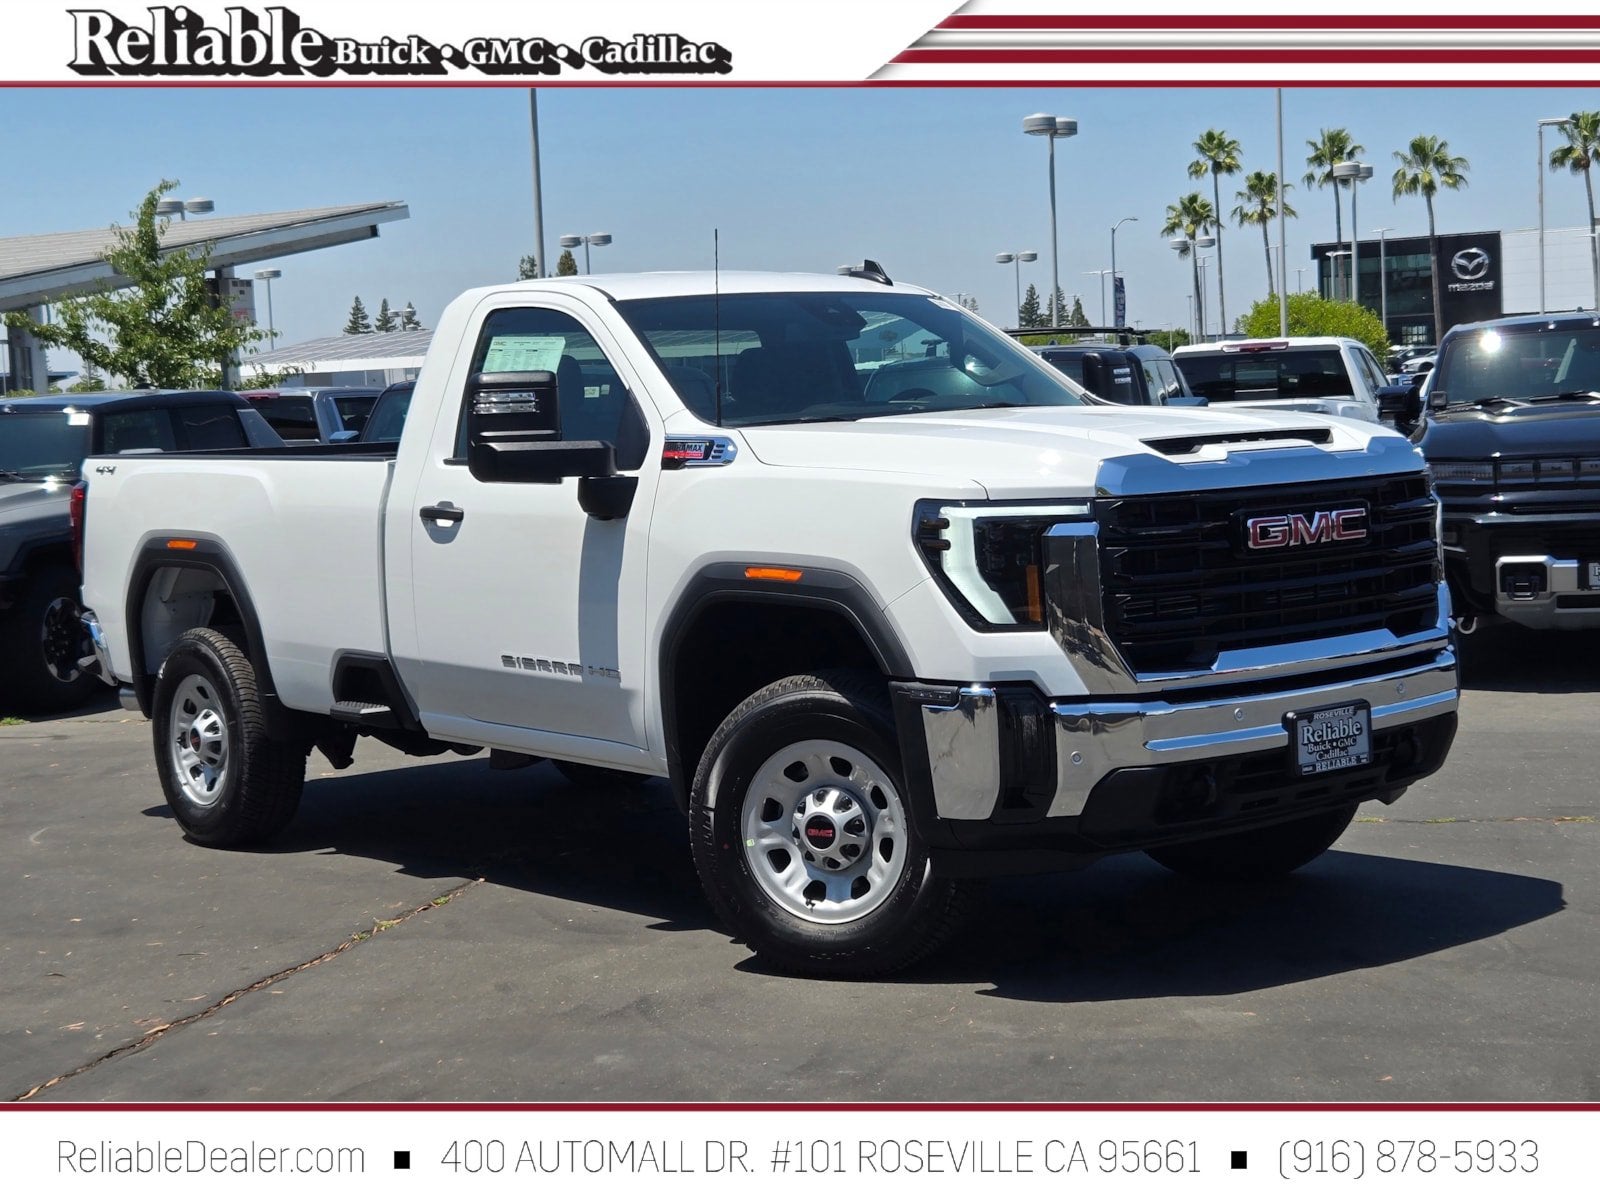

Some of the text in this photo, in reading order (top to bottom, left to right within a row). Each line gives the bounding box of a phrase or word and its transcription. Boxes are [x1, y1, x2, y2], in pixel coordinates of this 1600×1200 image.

[1448, 281, 1495, 292] mazda
[1247, 508, 1367, 549] GMC
[501, 655, 621, 681] SIERRA HD
[1313, 707, 1355, 720] ROSEVILLE
[1302, 717, 1362, 745] Reliable
[1308, 737, 1357, 753] Buick GMC
[1316, 748, 1348, 761] Cadillac
[1316, 757, 1357, 771] RELIABLE
